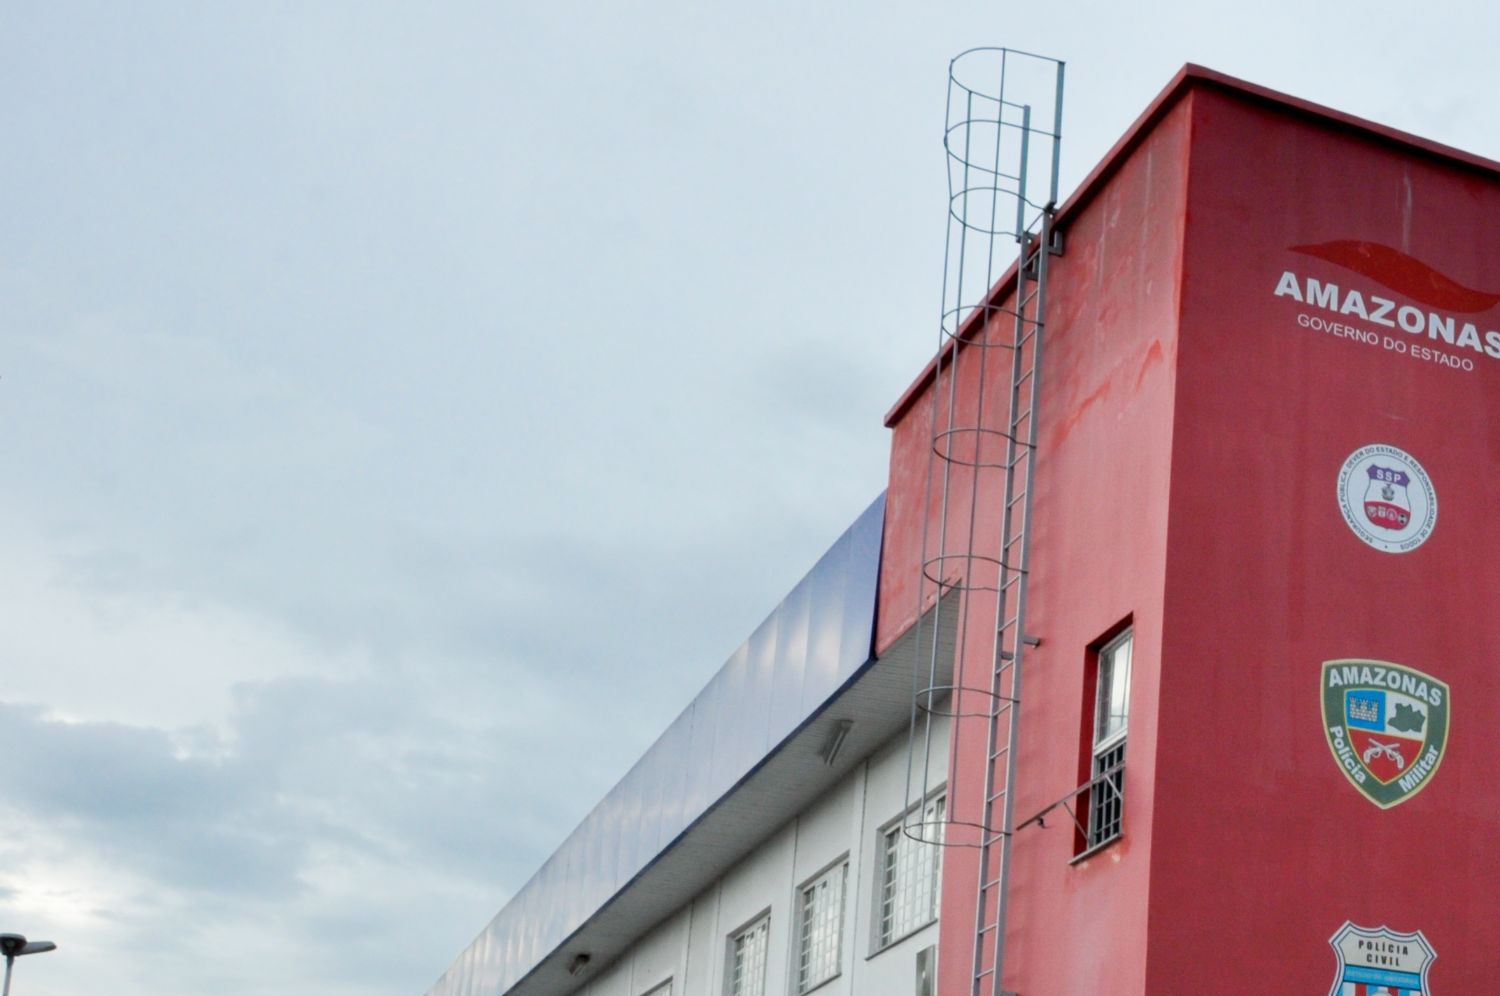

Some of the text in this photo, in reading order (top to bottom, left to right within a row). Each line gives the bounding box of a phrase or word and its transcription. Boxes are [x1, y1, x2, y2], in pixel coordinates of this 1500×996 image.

[1297, 313, 1474, 372] GOVERNO DO ESTADO
[1376, 470, 1402, 483] SSP
[1329, 666, 1442, 706] AMAZONAS
[1398, 745, 1439, 793] Militar
[1358, 940, 1409, 956] POLÍCIA
[1366, 953, 1400, 967] CIVIL
